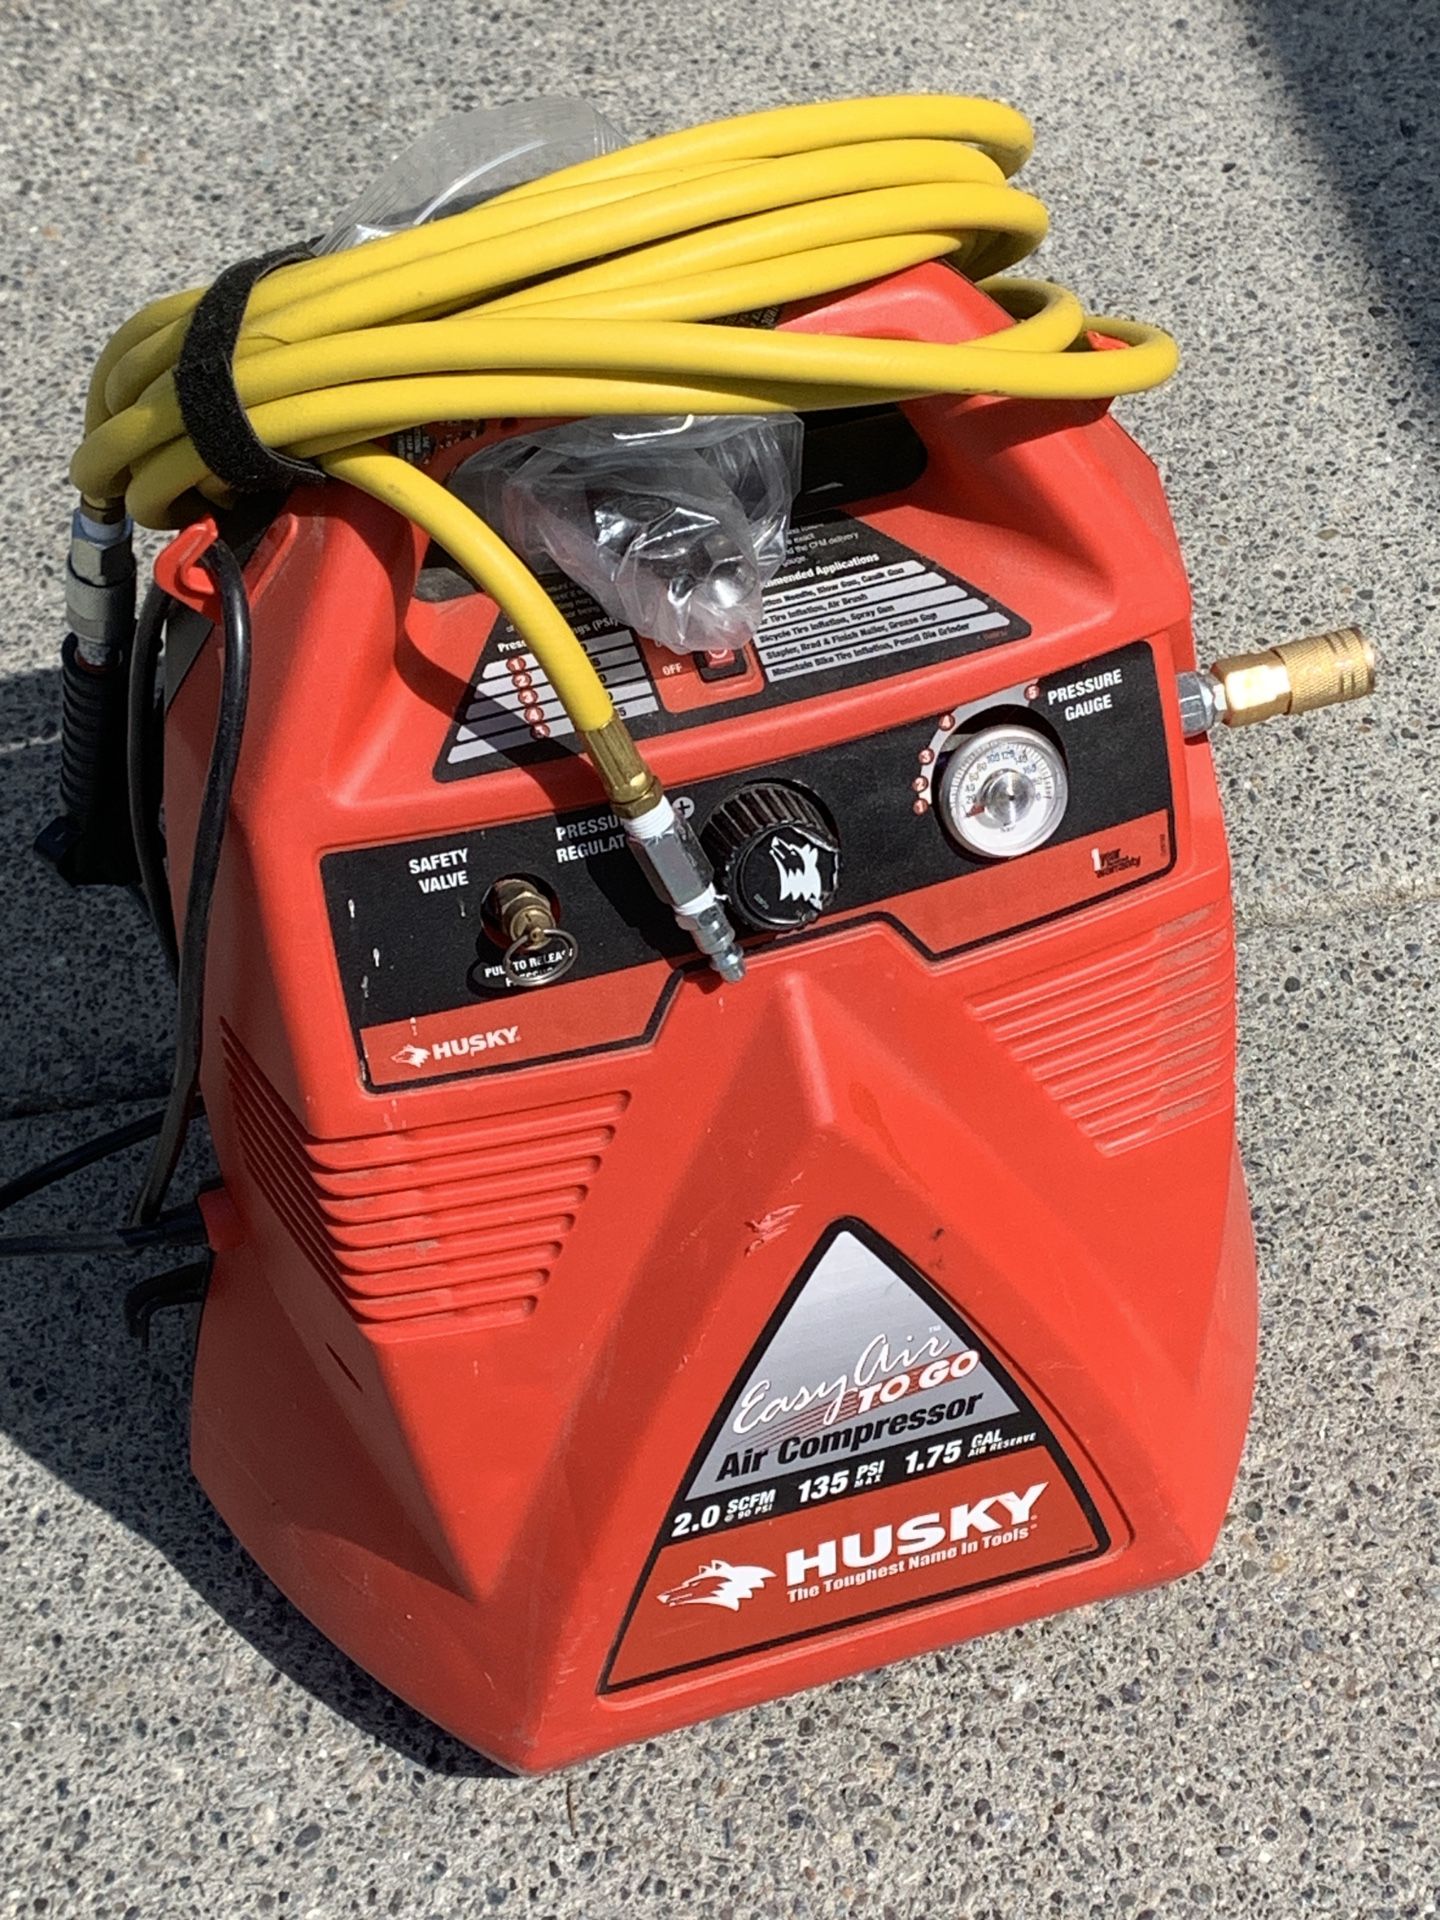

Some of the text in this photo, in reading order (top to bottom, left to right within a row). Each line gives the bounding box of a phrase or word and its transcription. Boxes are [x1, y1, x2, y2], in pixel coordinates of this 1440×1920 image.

[814, 553, 880, 576] Applications
[661, 662, 682, 677] OFF
[1047, 668, 1123, 706] PRESSURE
[1064, 693, 1113, 722] GAUGE
[555, 814, 625, 842] PRESSU
[408, 847, 469, 875] SAFETY
[555, 833, 627, 864] REGULAT
[418, 870, 470, 894] VALVE
[484, 964, 506, 979] PUL
[512, 959, 528, 972] TO
[432, 1026, 519, 1060] HUSKY
[733, 1374, 848, 1434] Easy
[853, 1333, 952, 1387] Air
[857, 1349, 980, 1414] TO GO
[714, 1392, 984, 1483] Air Compressor
[967, 1431, 1037, 1458] AIR RESERVE
[671, 1428, 1003, 1538] 2.0 SCFM 135 PSI 1.75 GAL
[853, 1473, 884, 1489] MAX
[737, 1508, 752, 1520] 90
[754, 1502, 773, 1515] PSI
[785, 1480, 1050, 1588] HUSKY
[786, 1527, 1029, 1604] The Toughest Name In Tools
